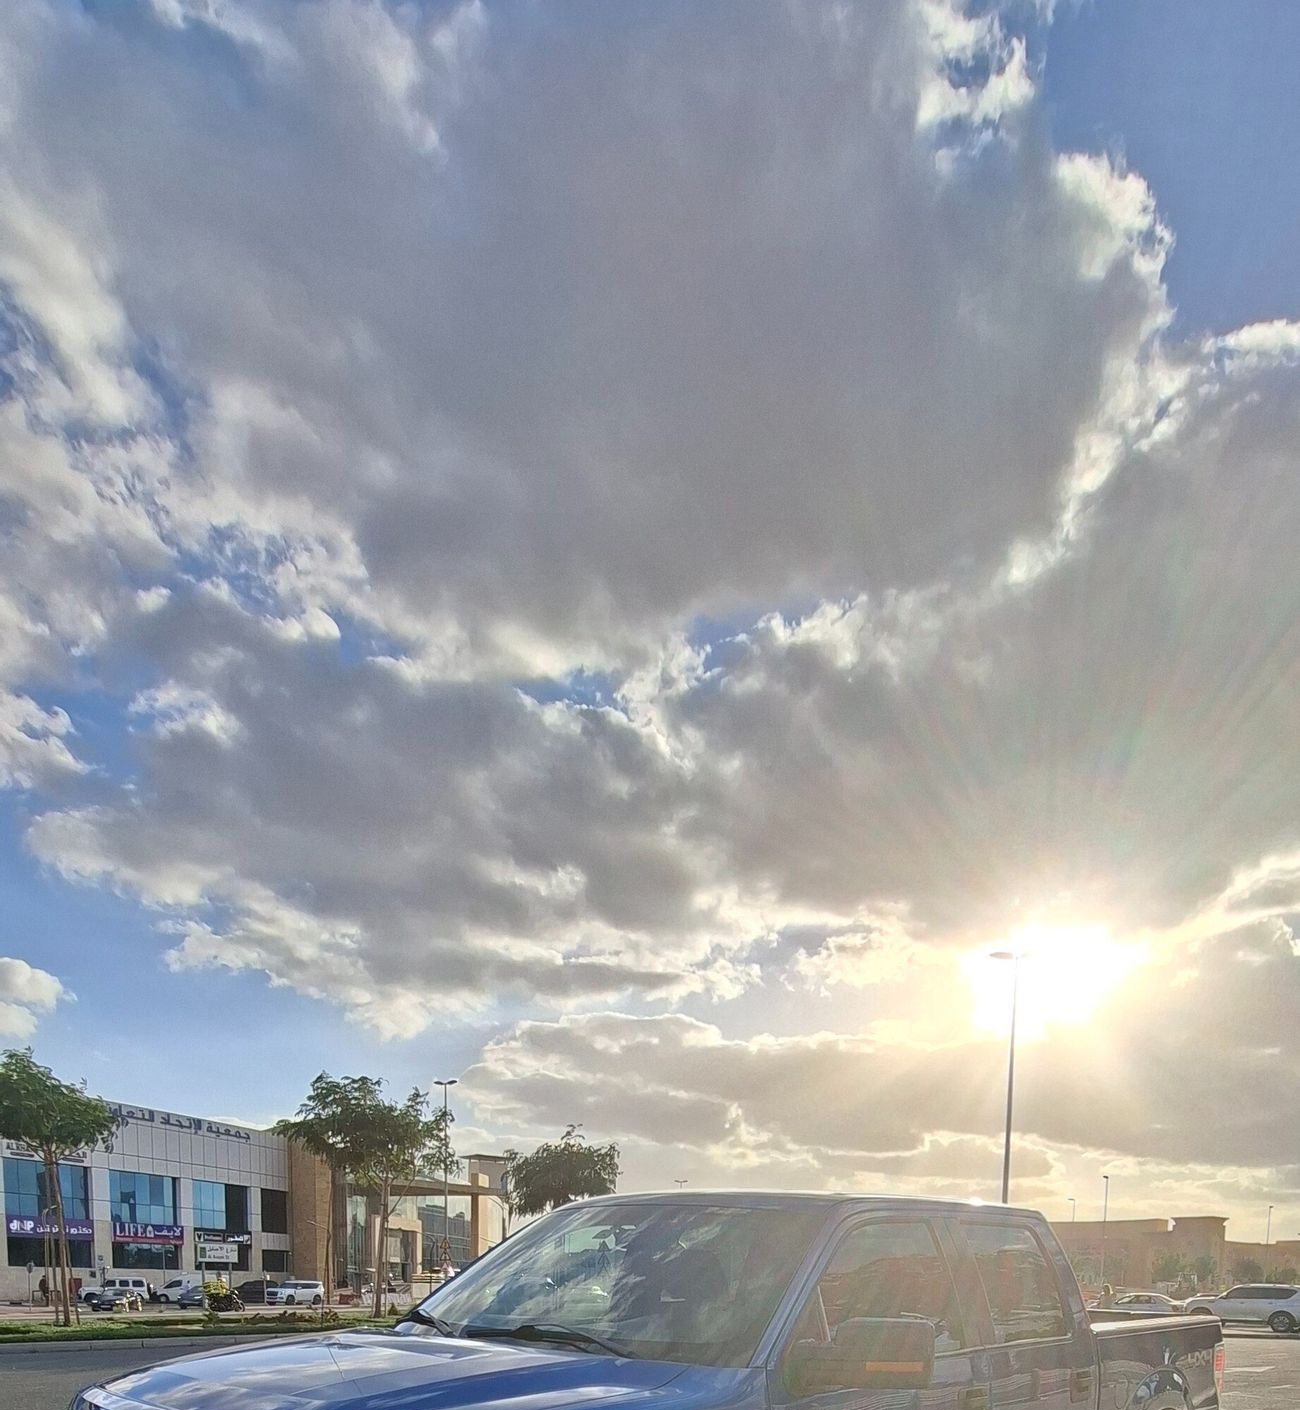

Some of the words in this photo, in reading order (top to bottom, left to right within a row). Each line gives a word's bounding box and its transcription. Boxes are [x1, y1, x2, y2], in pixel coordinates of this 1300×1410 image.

[206, 1121, 251, 1143] جمعية
[115, 1222, 146, 1238] LIFE
[154, 1226, 182, 1239] لايف
